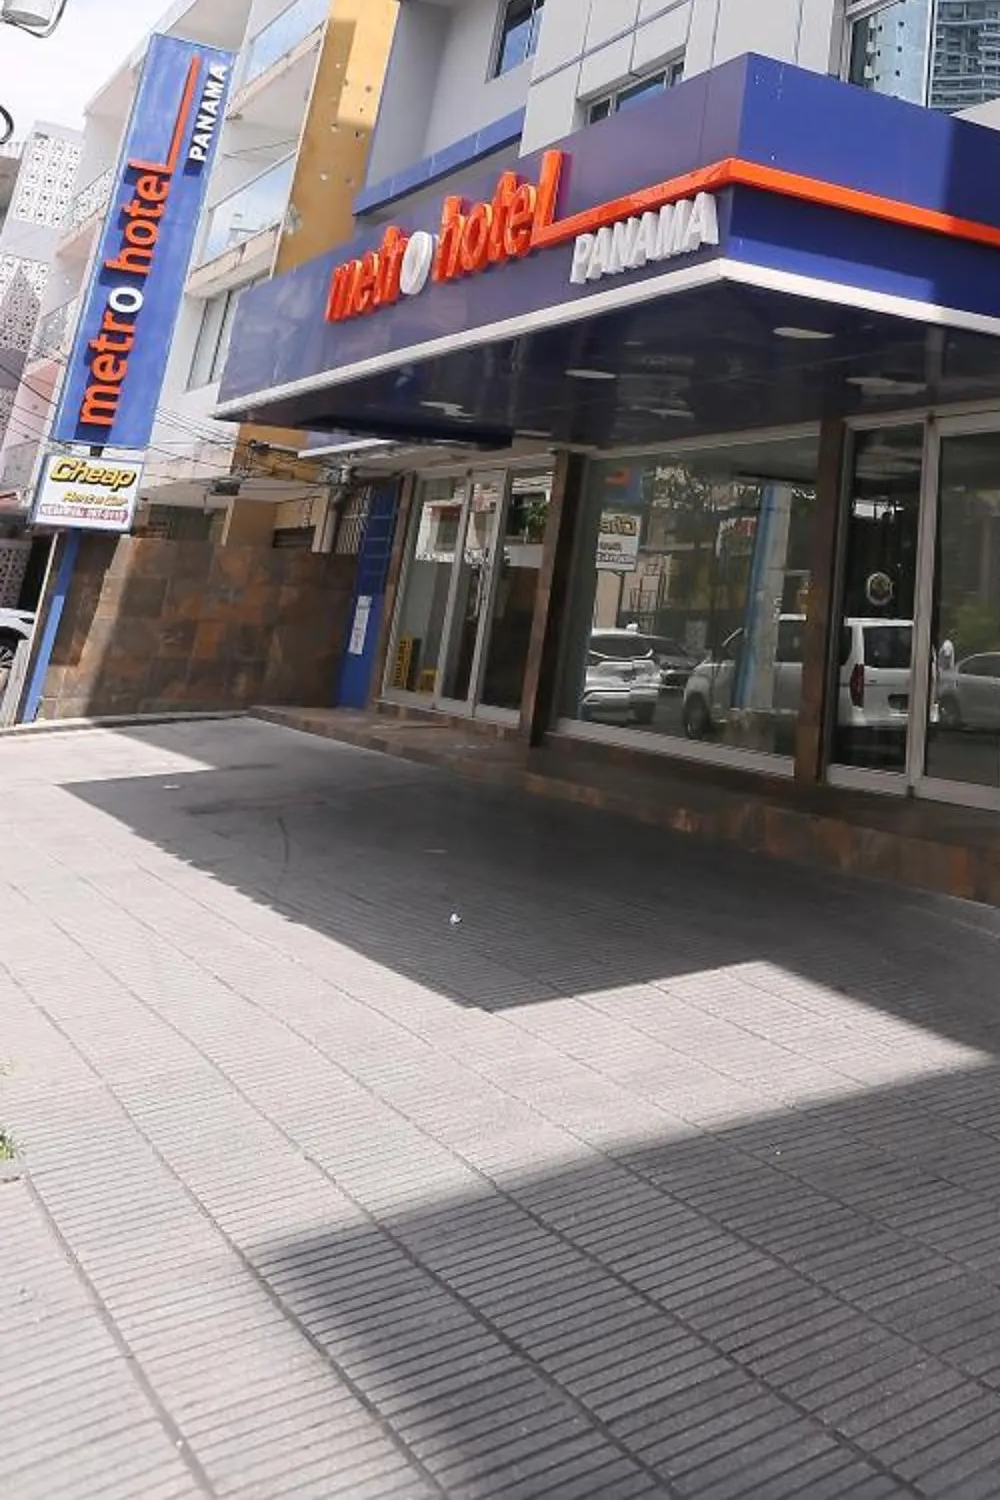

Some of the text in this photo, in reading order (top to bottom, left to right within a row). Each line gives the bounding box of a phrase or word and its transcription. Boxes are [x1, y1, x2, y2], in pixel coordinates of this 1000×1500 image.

[189, 64, 227, 162] PANAMA
[103, 157, 174, 275] hotel
[325, 148, 564, 323] metro hotel
[568, 191, 720, 285] PANAMA
[80, 286, 145, 426] metro
[50, 457, 137, 492] Cheap
